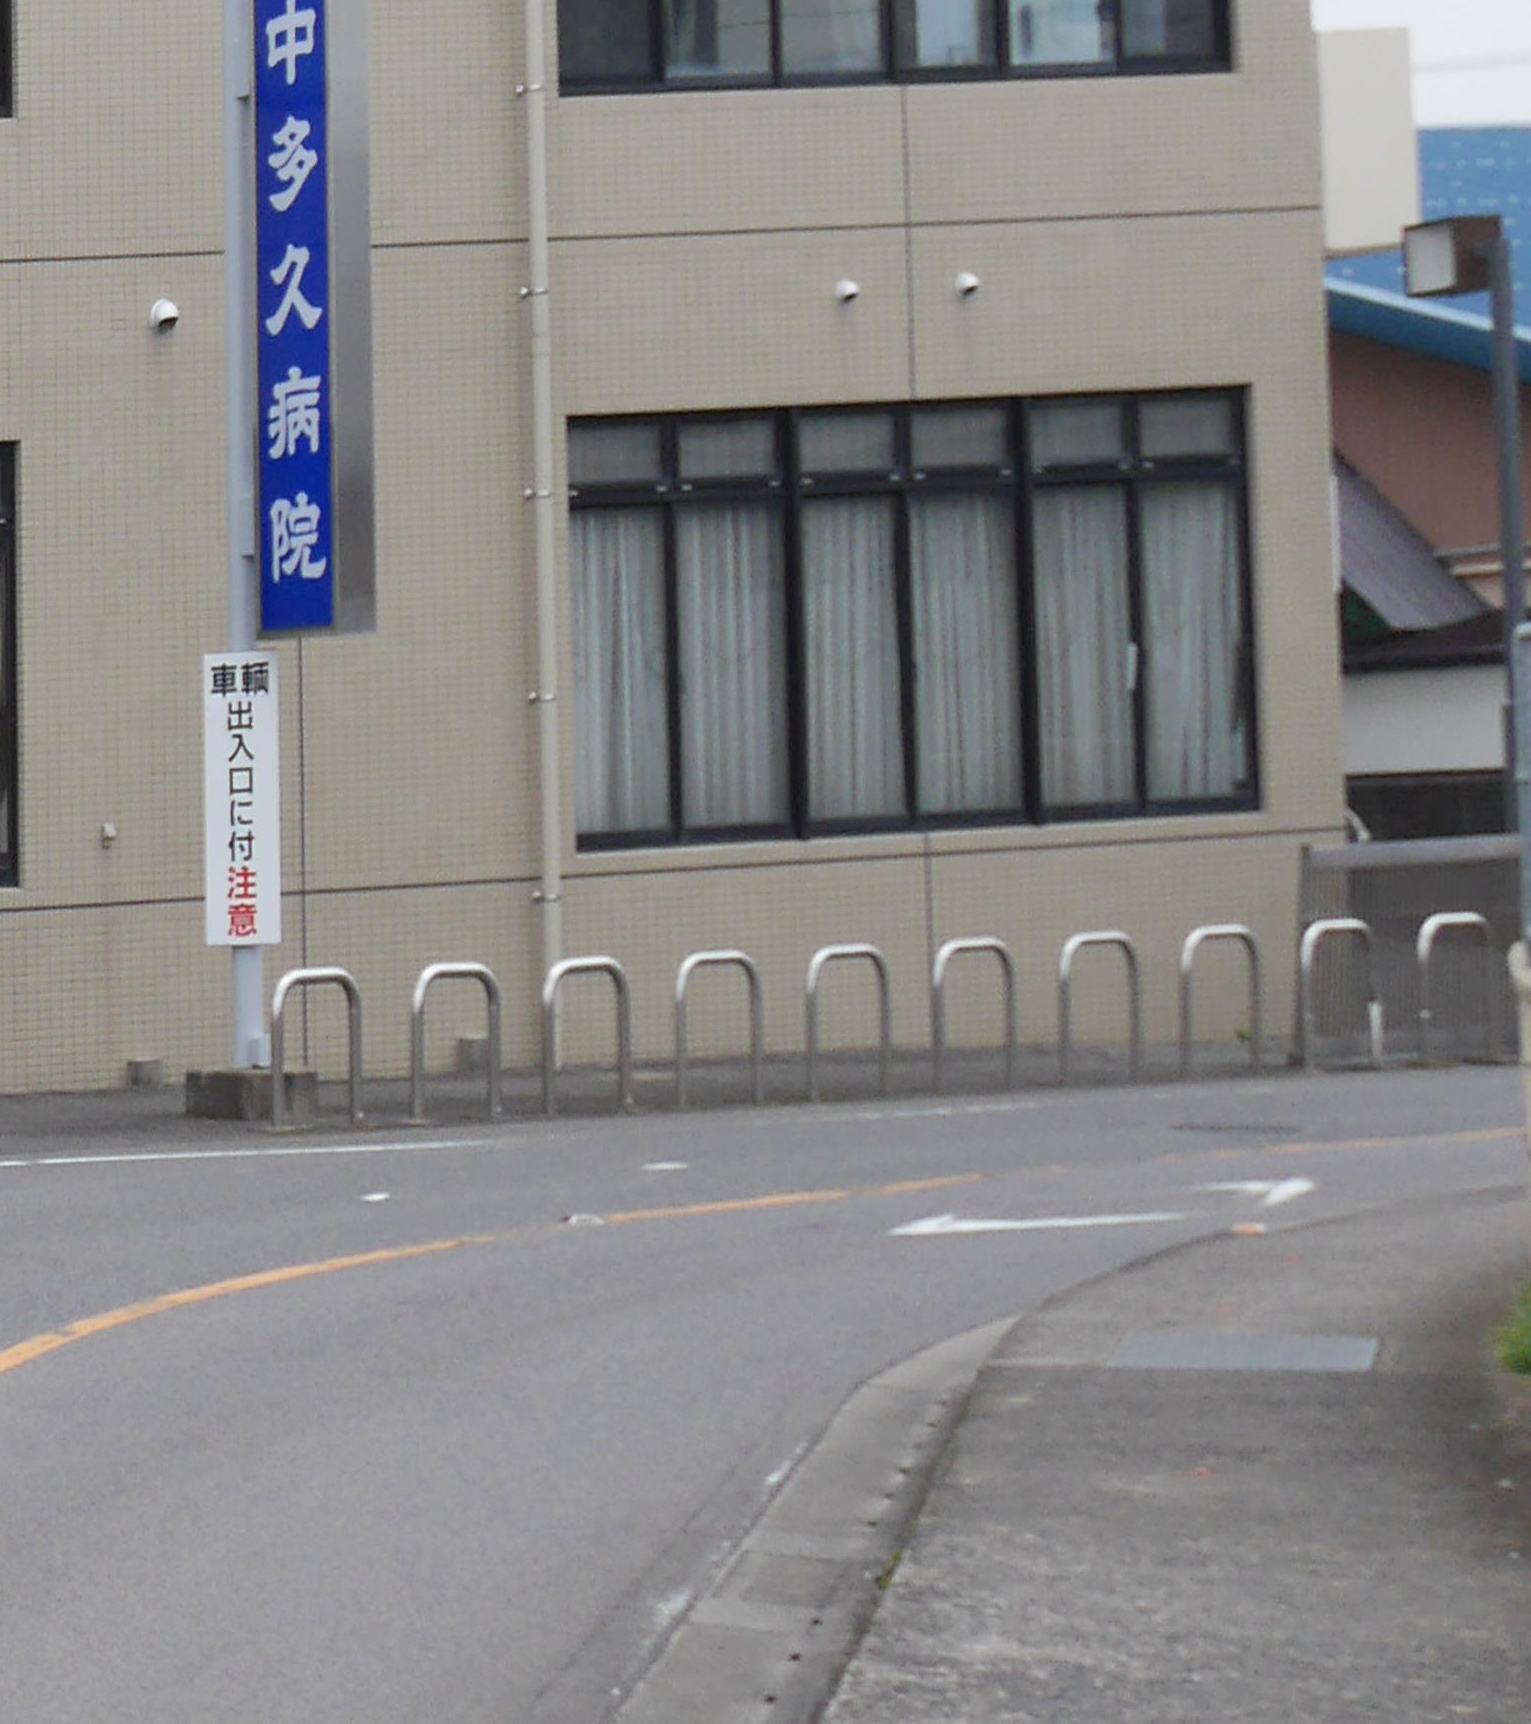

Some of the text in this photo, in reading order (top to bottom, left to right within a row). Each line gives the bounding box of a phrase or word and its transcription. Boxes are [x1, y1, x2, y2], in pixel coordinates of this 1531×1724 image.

[227, 700, 257, 937] 出入口に付注意
